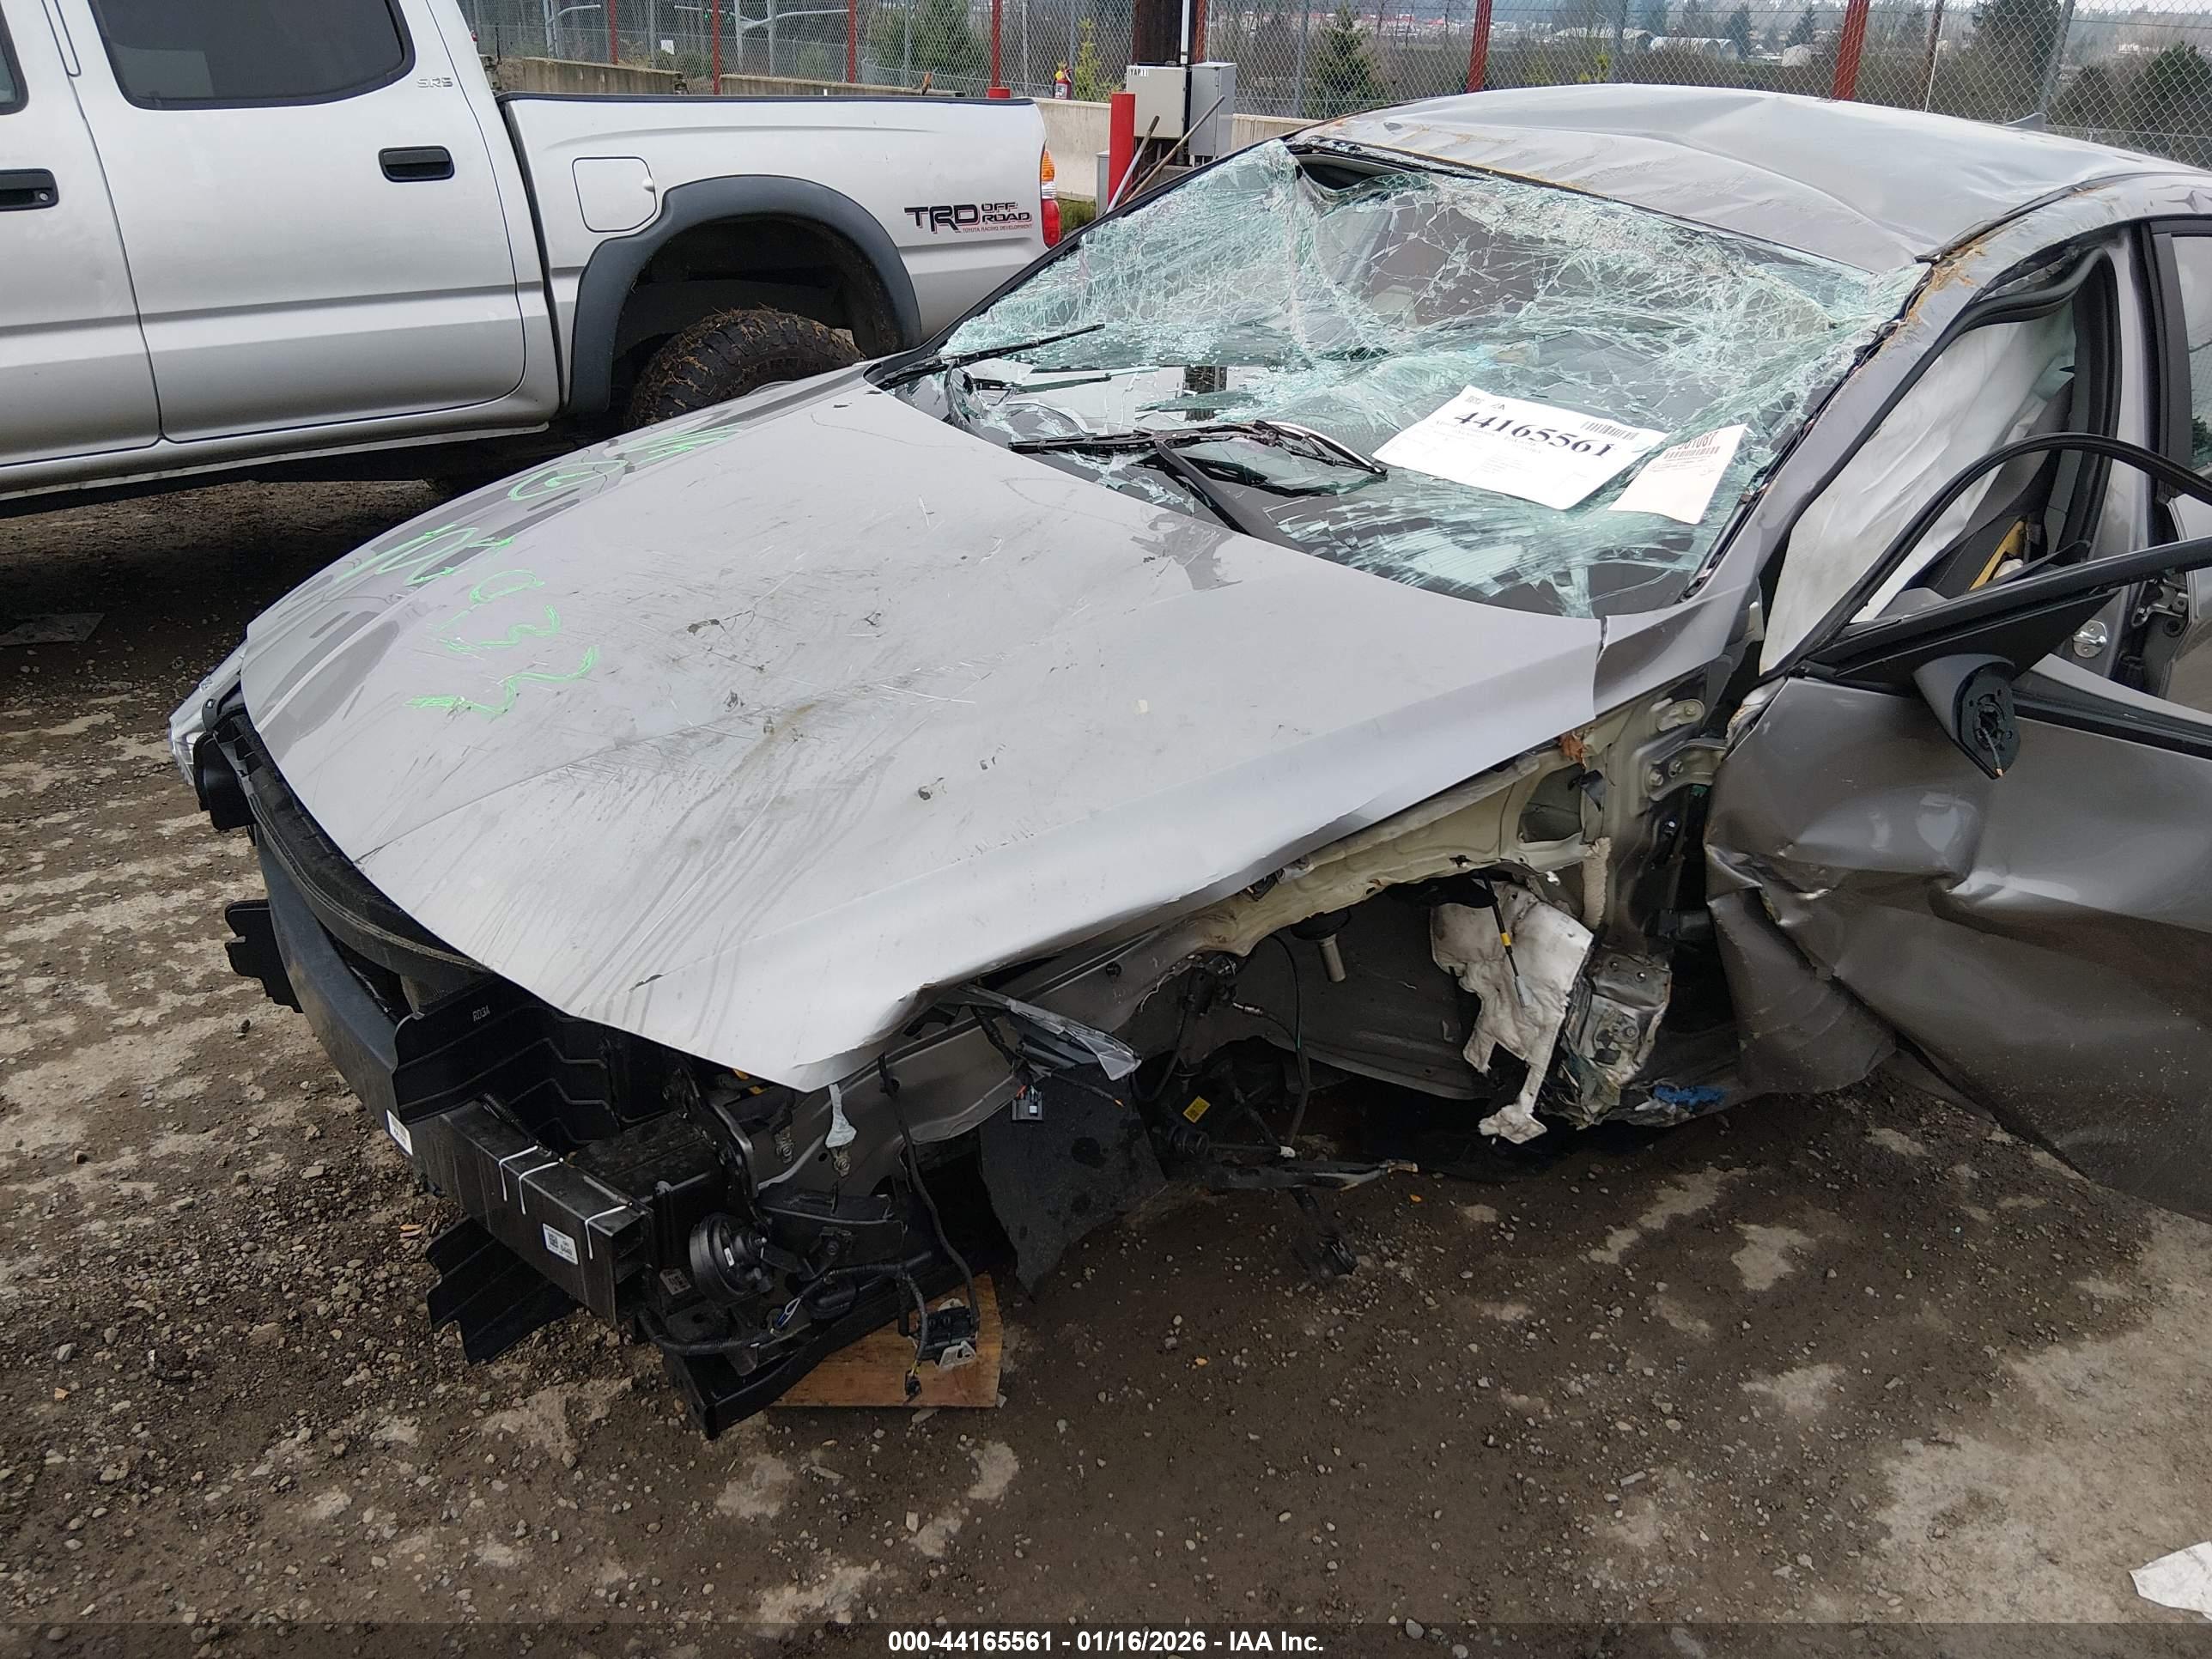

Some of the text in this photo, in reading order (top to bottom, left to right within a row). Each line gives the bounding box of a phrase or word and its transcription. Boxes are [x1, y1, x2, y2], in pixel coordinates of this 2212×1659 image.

[981, 202, 1018, 213] OFF
[903, 204, 980, 234] TRD
[981, 212, 1032, 225] ROAD
[1453, 411, 1615, 459] 44165561
